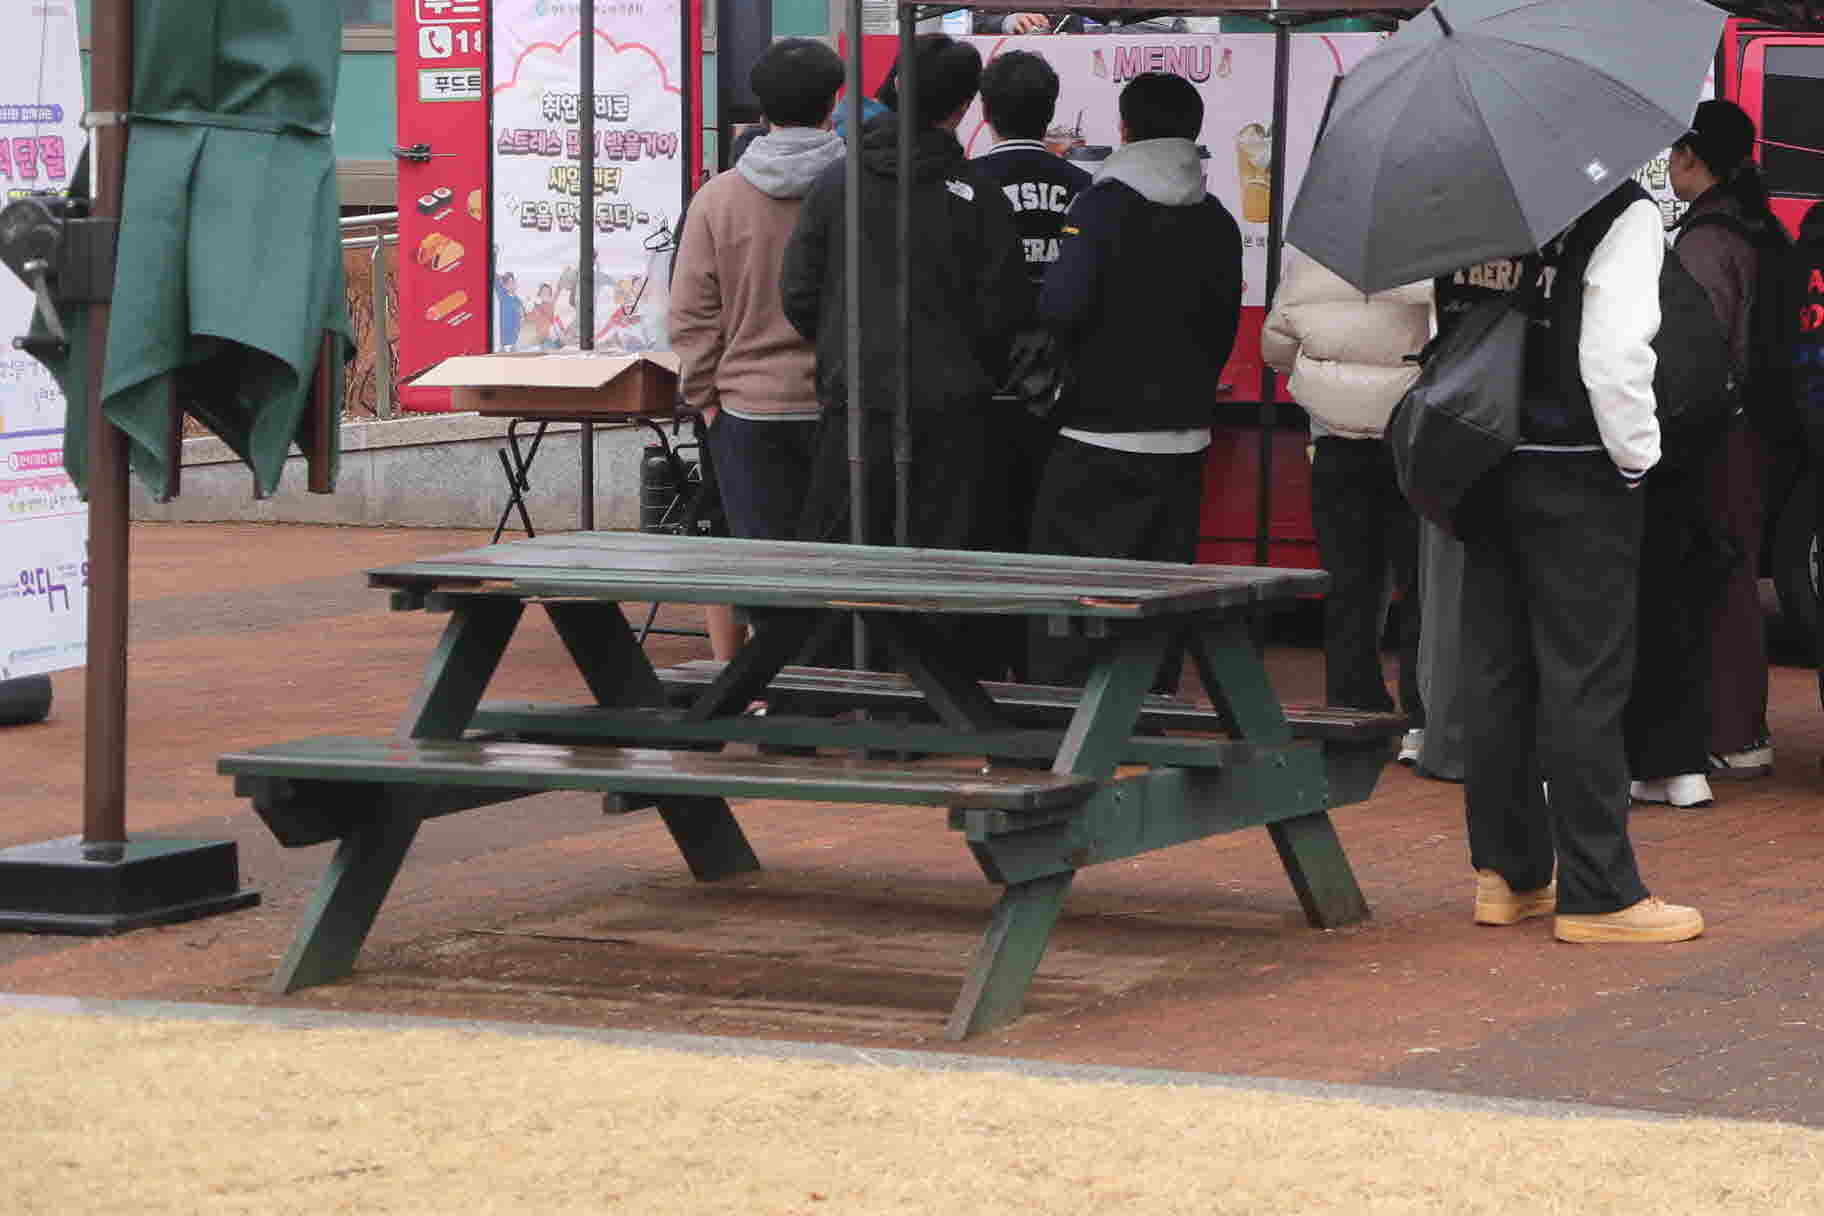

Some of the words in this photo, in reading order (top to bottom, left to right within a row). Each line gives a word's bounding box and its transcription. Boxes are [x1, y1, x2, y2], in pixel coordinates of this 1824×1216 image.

[1112, 45, 1212, 83] MENU
[543, 92, 629, 122] 취업비로
[497, 128, 561, 155] 스트레스
